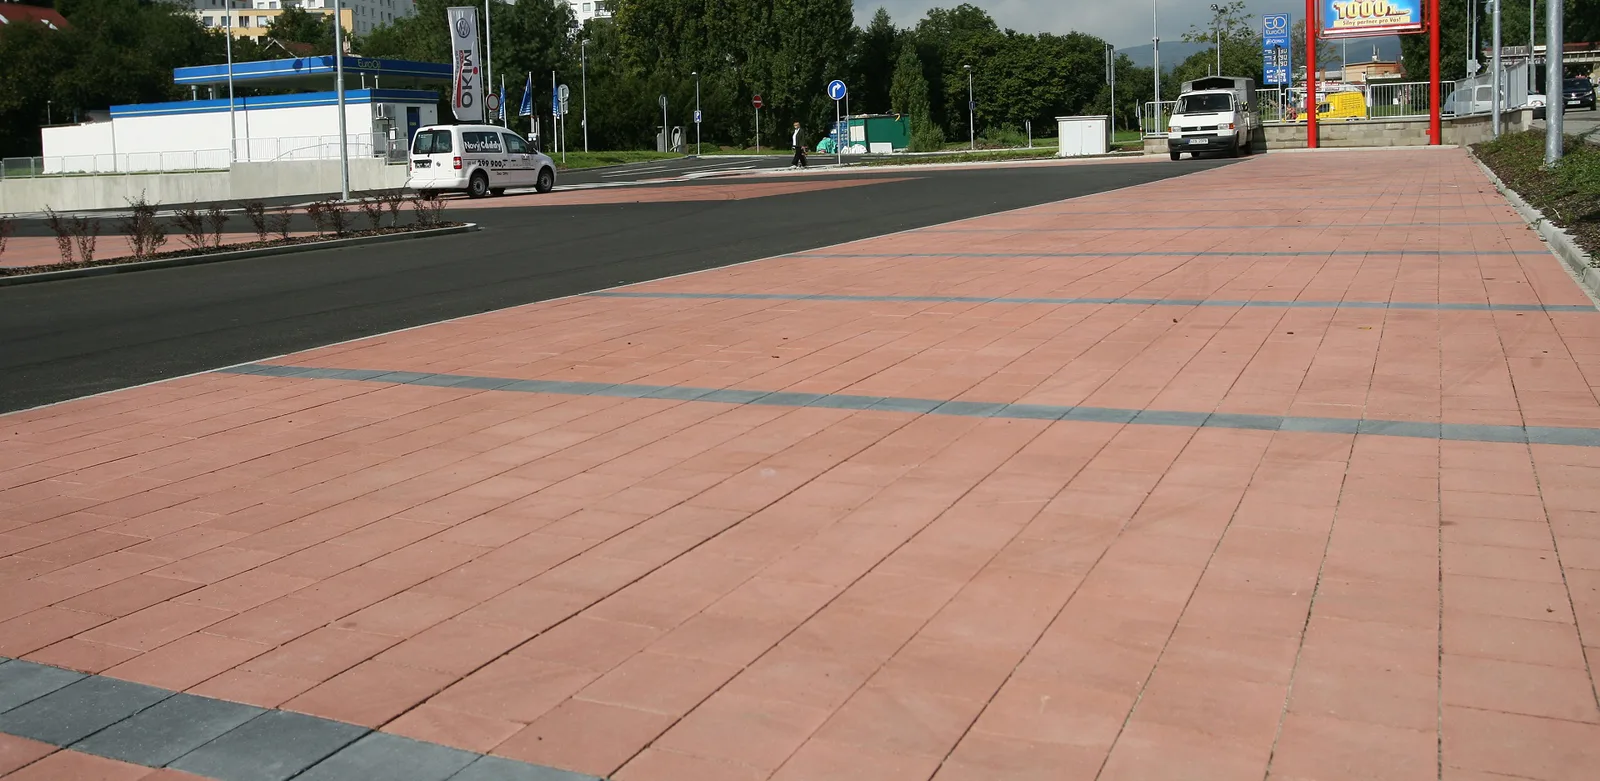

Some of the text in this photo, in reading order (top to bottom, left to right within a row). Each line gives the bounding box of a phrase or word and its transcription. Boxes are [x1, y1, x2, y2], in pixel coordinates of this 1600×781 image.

[1334, 0, 1388, 19] 1000
[1357, 18, 1377, 26] partner
[480, 141, 501, 151] Caddy
[478, 159, 489, 167] 299
